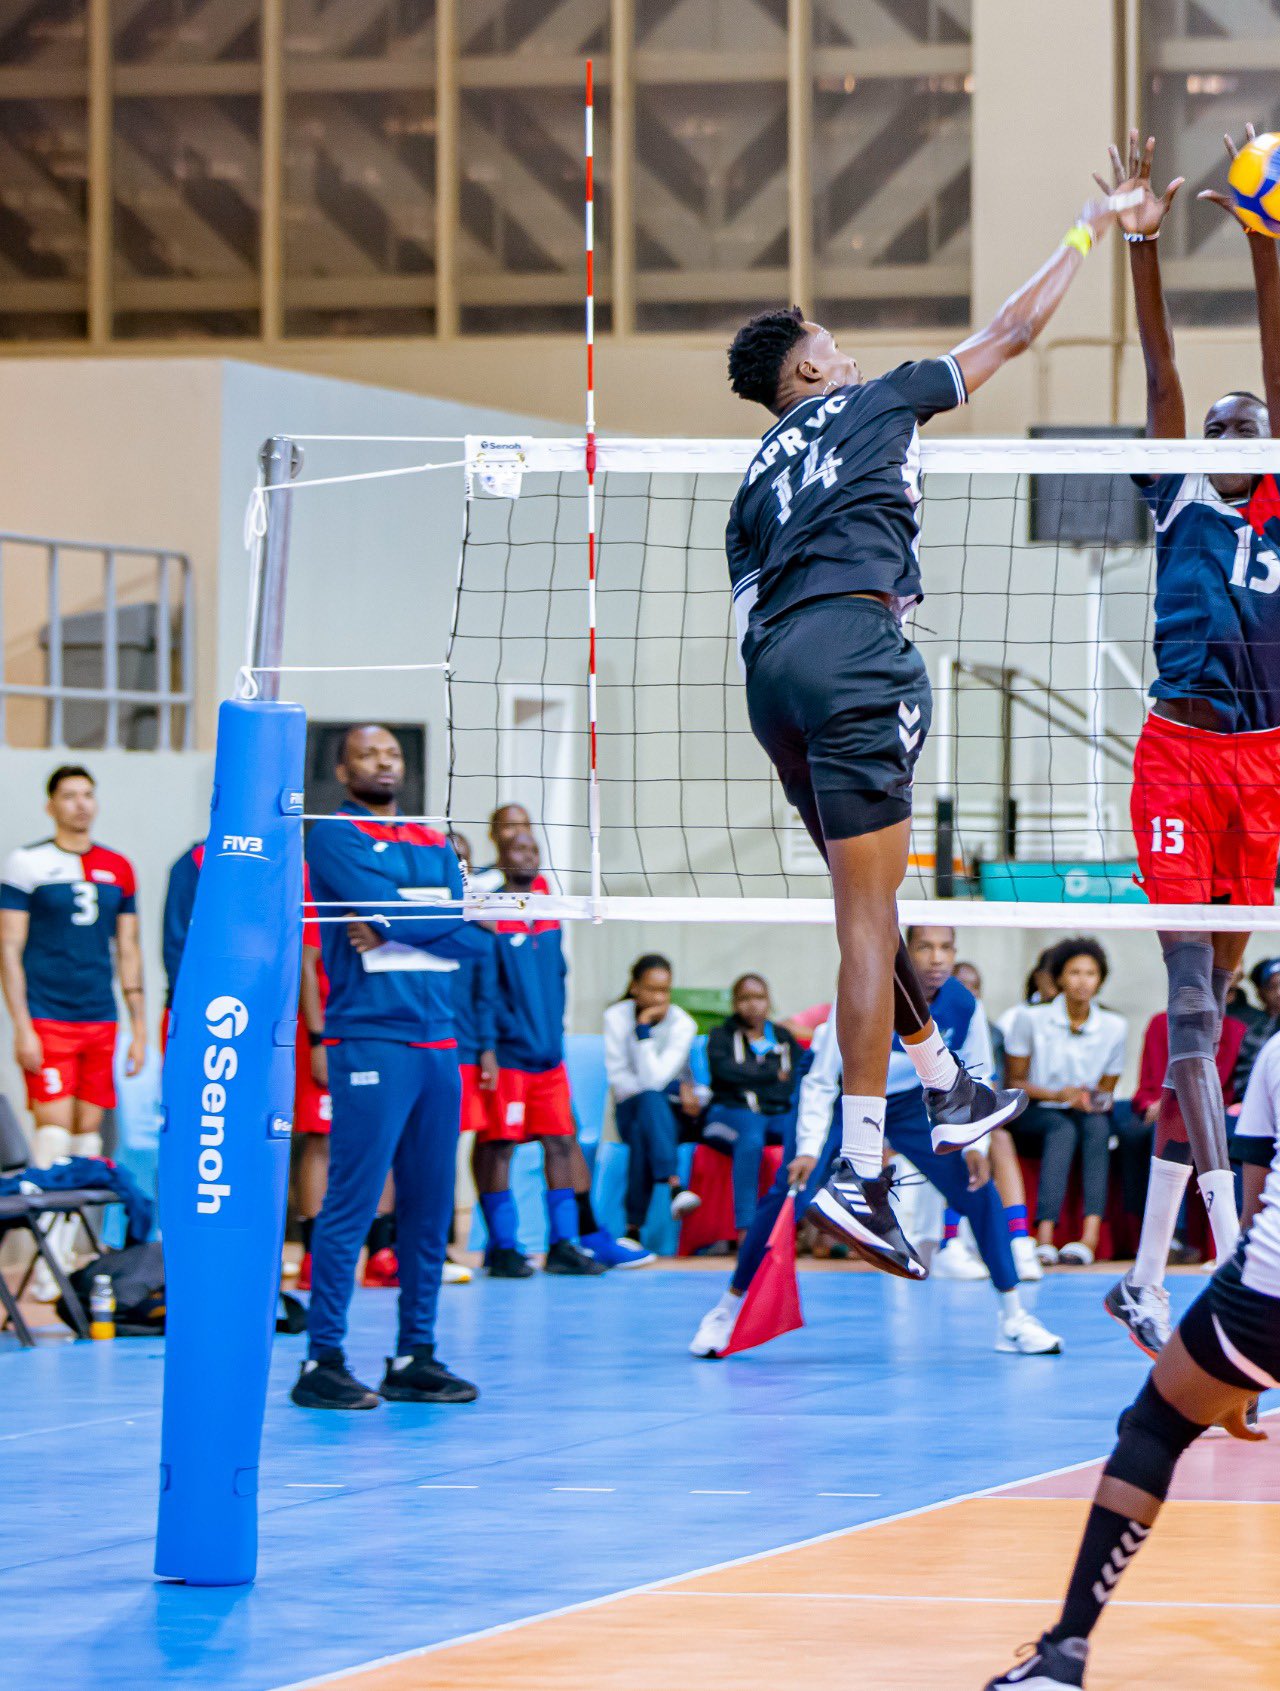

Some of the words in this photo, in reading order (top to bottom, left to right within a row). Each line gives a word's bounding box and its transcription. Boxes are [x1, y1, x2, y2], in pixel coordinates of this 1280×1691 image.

[749, 427, 809, 486] APR
[804, 395, 848, 429] VC
[771, 436, 843, 525] 14
[1151, 816, 1184, 854] 13
[70, 881, 99, 926] 3
[42, 1067, 63, 1095] 3
[197, 1044, 238, 1214] Senoh
